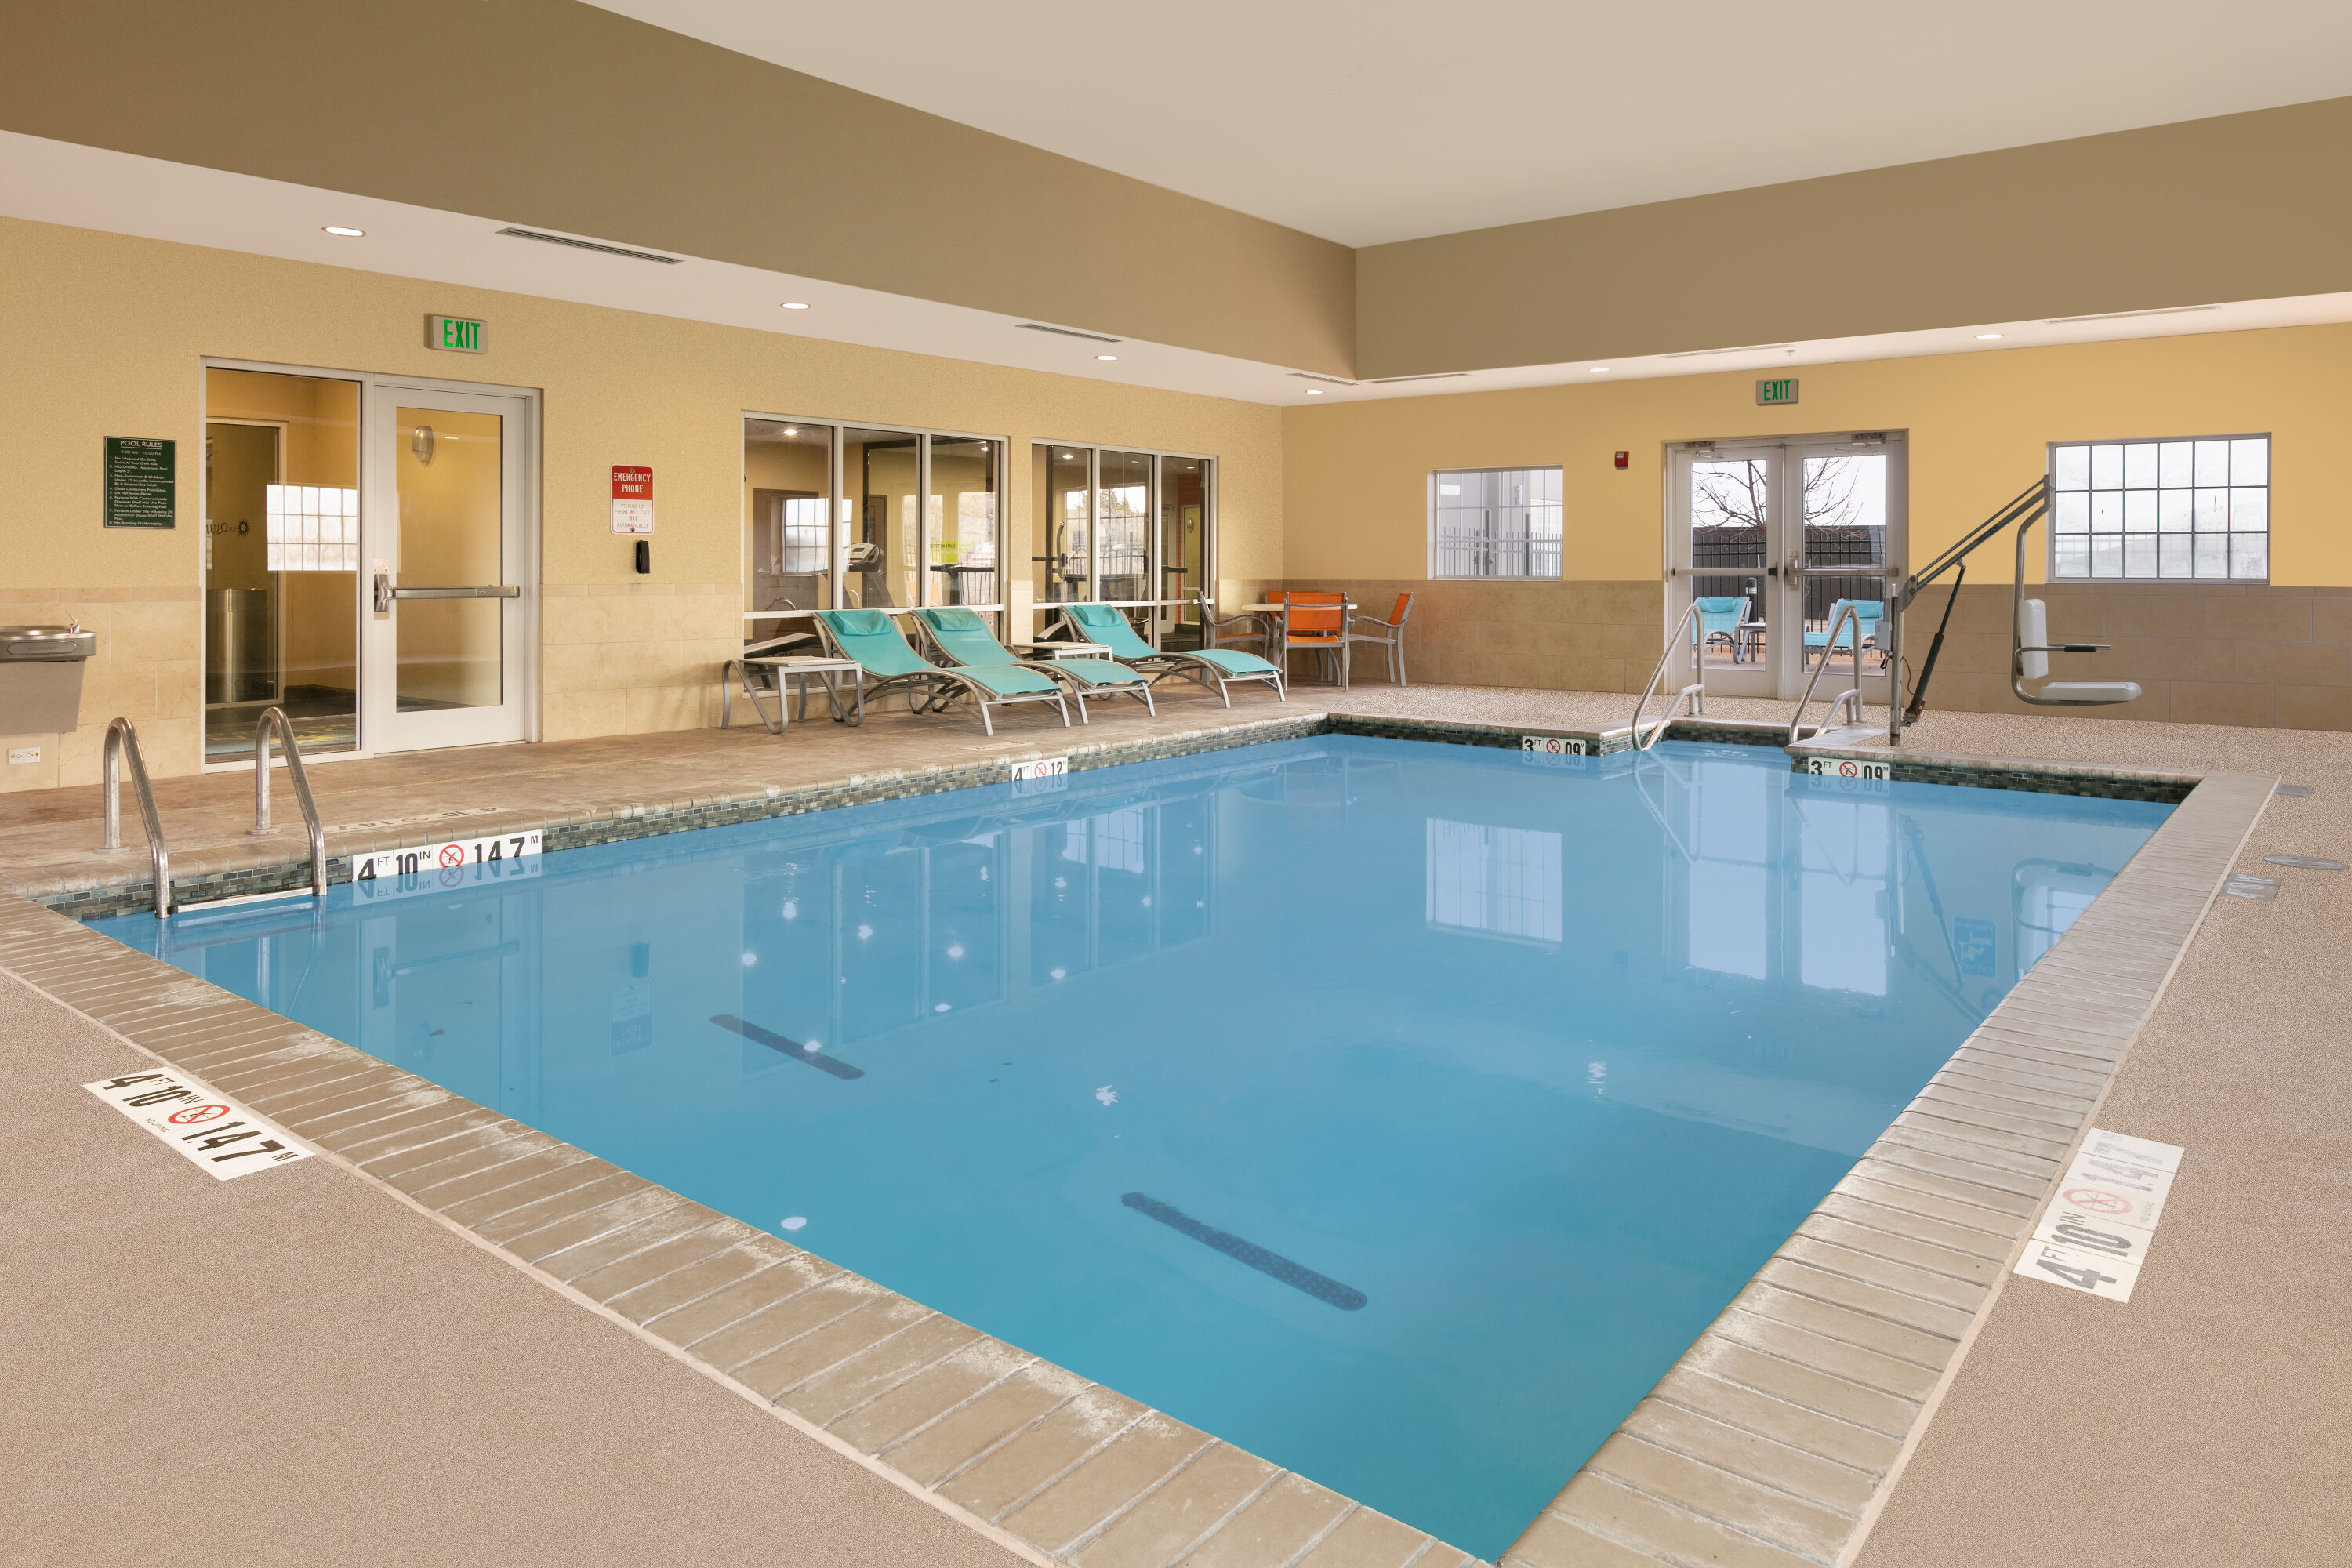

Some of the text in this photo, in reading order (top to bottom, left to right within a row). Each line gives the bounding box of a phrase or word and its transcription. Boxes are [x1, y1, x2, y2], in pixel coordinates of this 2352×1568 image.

[444, 319, 480, 350] EXIT
[1764, 380, 1790, 401] EXIT
[614, 473, 651, 482] EMERGENCY
[622, 484, 643, 493] PHONE
[1524, 739, 1533, 751] 3
[1014, 767, 1023, 781] 4
[1811, 761, 1822, 775] 3
[357, 859, 377, 880] 4
[377, 856, 389, 867] FT
[396, 853, 418, 875] 10
[420, 850, 431, 860] IN
[530, 835, 538, 844] M
[103, 1074, 165, 1090] 4
[122, 1085, 192, 1107] 10
[178, 1094, 204, 1104] IN
[151, 1122, 170, 1132] DIVING
[180, 1121, 286, 1162] 1.47
[271, 1151, 299, 1162] M
[2059, 1211, 2086, 1226] IN
[2051, 1224, 2132, 1257] 10
[2040, 1246, 2070, 1262] FT
[2036, 1258, 2117, 1289] 4
